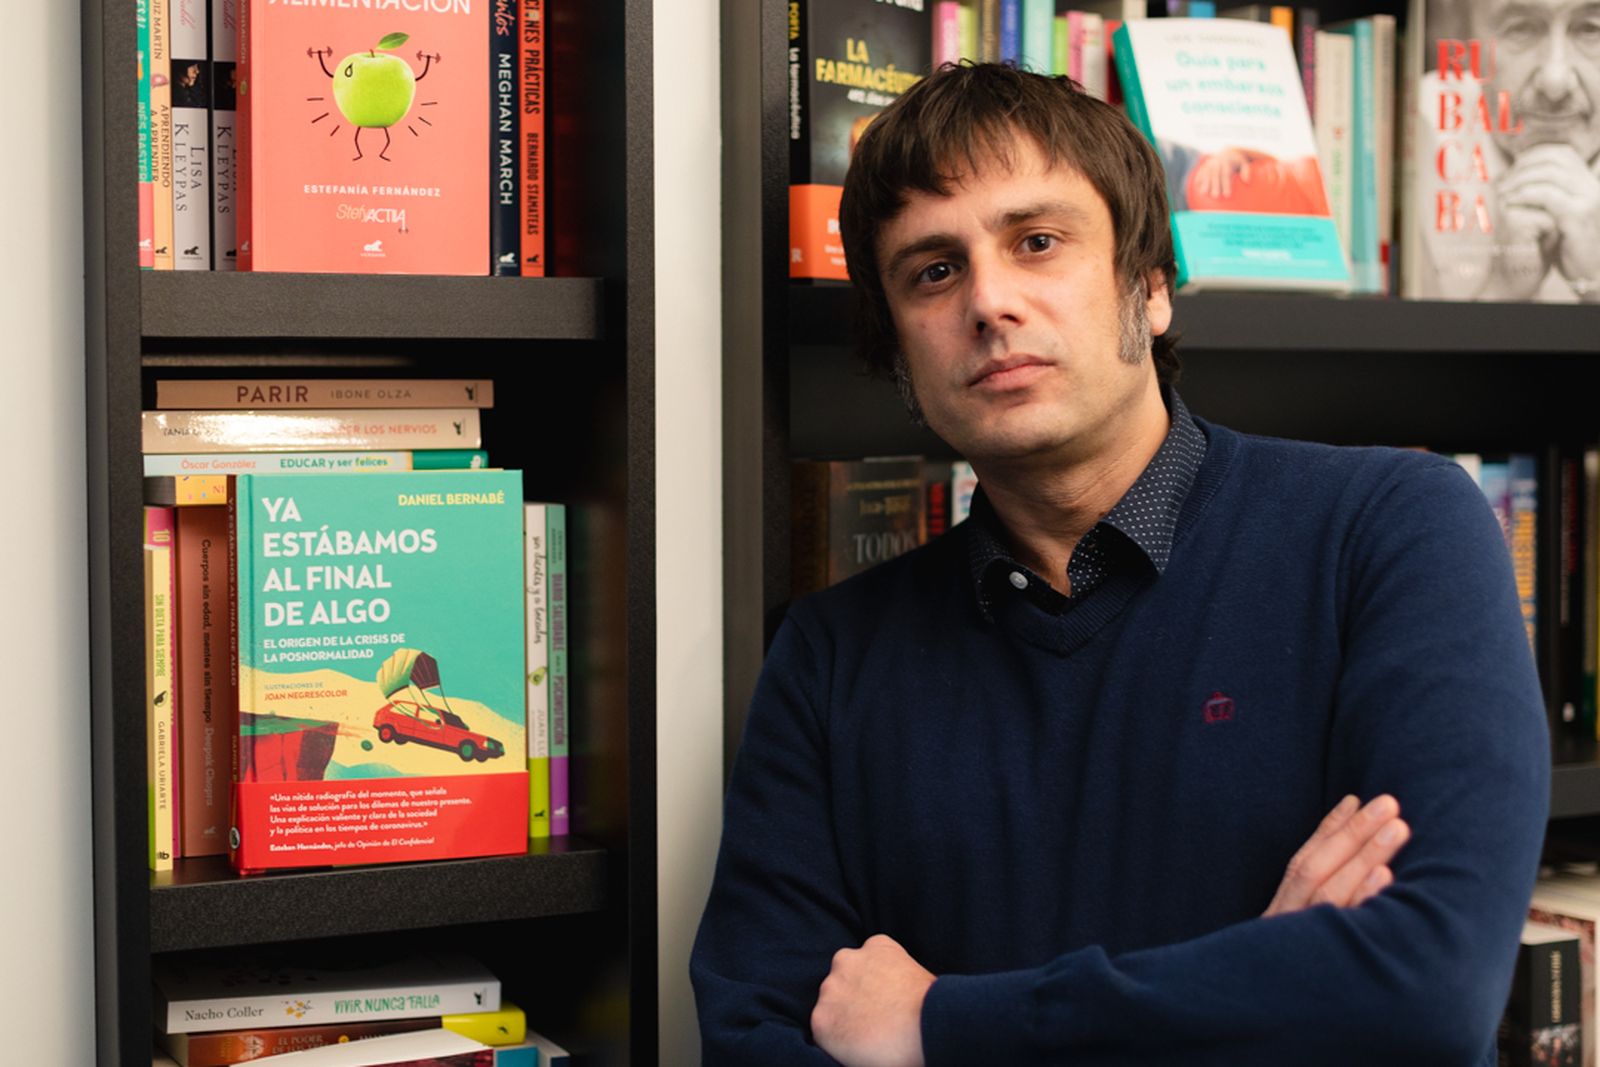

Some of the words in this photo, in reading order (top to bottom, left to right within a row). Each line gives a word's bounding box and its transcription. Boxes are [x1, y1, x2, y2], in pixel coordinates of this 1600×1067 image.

[846, 37, 869, 64] LA
[499, 53, 512, 131] MEGHAN
[525, 49, 544, 114] PRÁCTICAS
[161, 104, 170, 188] APRENDIENDO
[527, 132, 539, 181] BERNARDO
[174, 123, 189, 211] KLEYPAS
[190, 146, 205, 189] LISA
[217, 125, 232, 213] KLEYPAS
[500, 139, 513, 204] MARCH
[304, 184, 368, 195] ESTEFANÍA
[372, 185, 441, 197] FERNÁNDEZ
[527, 184, 539, 235] STAMATEAS
[237, 386, 309, 402] PARIR
[331, 389, 370, 399] IBONE
[377, 389, 412, 399] OLZA
[364, 425, 385, 434] LOS
[388, 424, 437, 434] NERVIOS
[212, 459, 256, 469] González
[280, 458, 326, 467] EDUCAR
[336, 459, 352, 467] ser
[355, 458, 388, 467] felices
[261, 496, 302, 522] YA
[398, 493, 444, 506] DANIEL
[446, 489, 505, 505] BERNABÉ
[263, 524, 438, 557] ESTÁBAMOS
[201, 539, 211, 581] Cuerpos
[262, 566, 301, 592] AL
[306, 564, 392, 590] FINAL
[204, 585, 212, 599] sin
[203, 601, 212, 630] edad,
[264, 601, 304, 627] DE
[309, 598, 390, 625] ALGO
[204, 632, 212, 668] mentes
[263, 639, 277, 648] EL
[279, 637, 321, 648] ORIGEN
[323, 636, 337, 646] DE
[339, 635, 353, 645] LA
[355, 634, 389, 644] CRISIS
[390, 633, 405, 643] DE
[263, 653, 278, 663] LA
[280, 649, 374, 662] POSNORMALIDAD
[204, 671, 212, 686] sin
[203, 687, 213, 723] tiempo
[264, 692, 286, 701] JOAN
[288, 690, 348, 699] NEGRESCOLOR
[158, 721, 166, 768] GABRIELA
[270, 815, 286, 823] Una
[331, 812, 360, 821] valiente
[388, 811, 397, 819] de
[406, 809, 438, 818] sociedad
[341, 804, 358, 813] para
[400, 799, 410, 807] de
[338, 824, 368, 833] tiempos
[369, 822, 379, 830] de
[185, 1009, 224, 1022] Nacho
[226, 1006, 264, 1019] Coller
